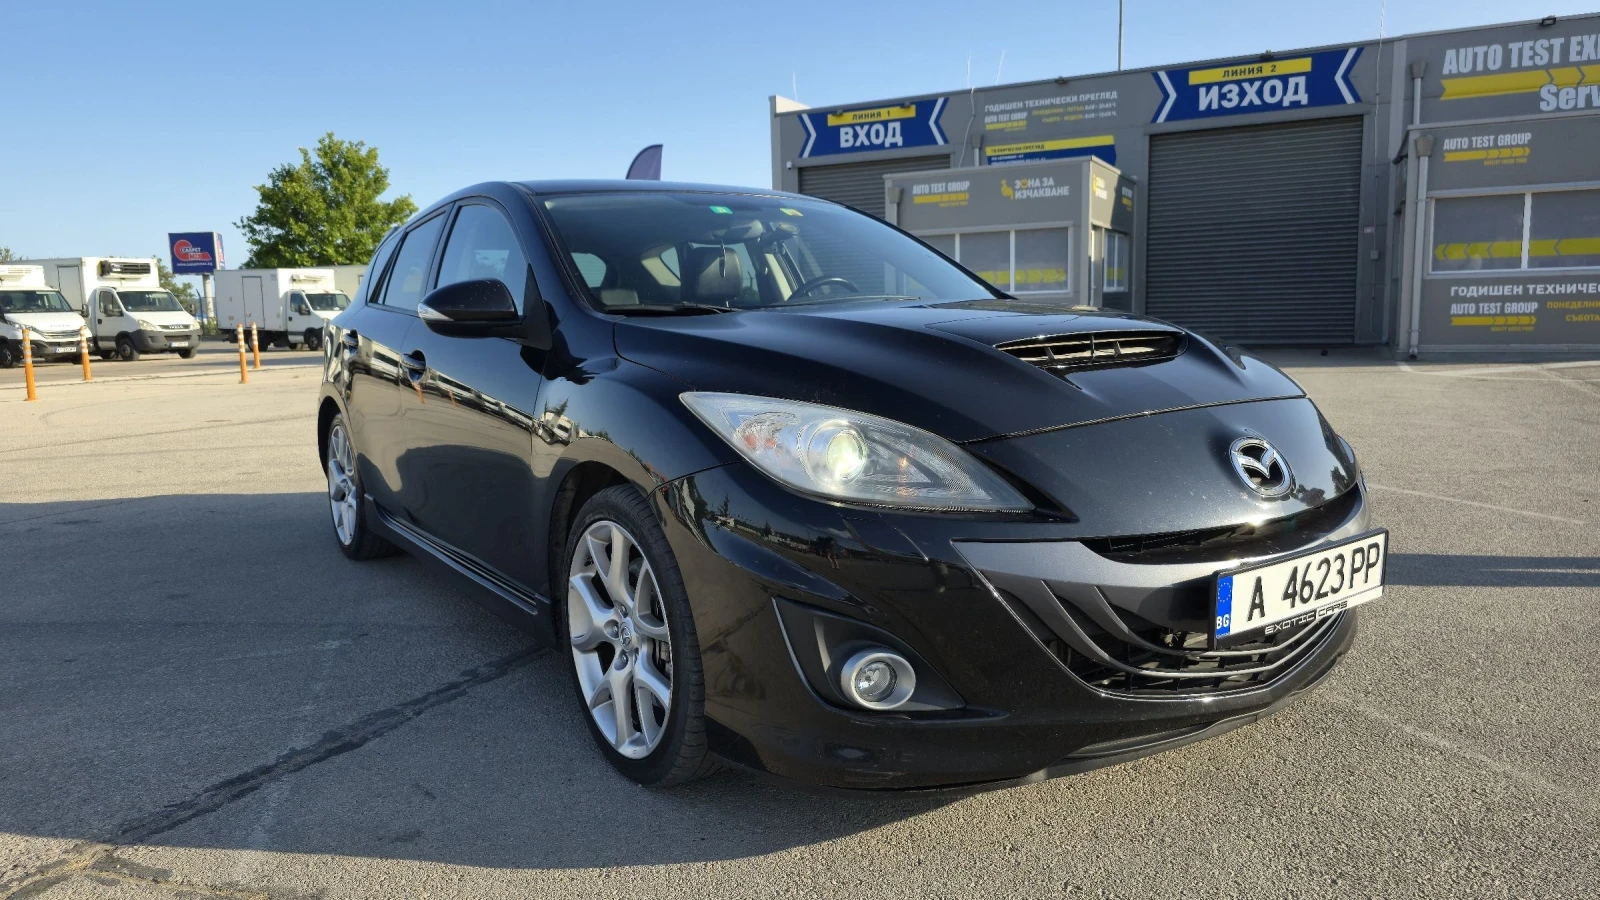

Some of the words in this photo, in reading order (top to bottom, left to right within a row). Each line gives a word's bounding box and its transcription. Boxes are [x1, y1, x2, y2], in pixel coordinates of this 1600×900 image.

[1442, 44, 1503, 75] AUTO
[1508, 37, 1565, 68] TEST
[1568, 33, 1600, 62] EX
[1222, 66, 1264, 78] ЛИНИЯ
[1270, 64, 1277, 73] 2
[1079, 91, 1118, 102] ПРЕГЛЕД
[1198, 76, 1309, 112] ИЗХОД
[852, 112, 882, 121] ЛИНИЯ
[840, 122, 904, 148] ВХОД
[1443, 138, 1469, 150] AUTO
[1472, 135, 1495, 148] TEST
[1498, 132, 1532, 146] GROUP
[913, 184, 929, 195] AUTO
[931, 183, 946, 193] TEST
[948, 180, 970, 192] GROUP
[1015, 179, 1041, 190] ЗОНА
[1042, 177, 1055, 187] ЗА
[1015, 186, 1070, 200] ИЗЧАКВАНЕ
[1450, 285, 1523, 298] ГОДИШЕН
[1450, 303, 1476, 315] AUTO
[1478, 302, 1502, 314] TEST
[1504, 301, 1538, 314] GROUP
[1247, 576, 1265, 622] A
[1216, 614, 1230, 629] BG
[1265, 612, 1315, 634] EXOTIC
[1318, 600, 1348, 616] CARS
